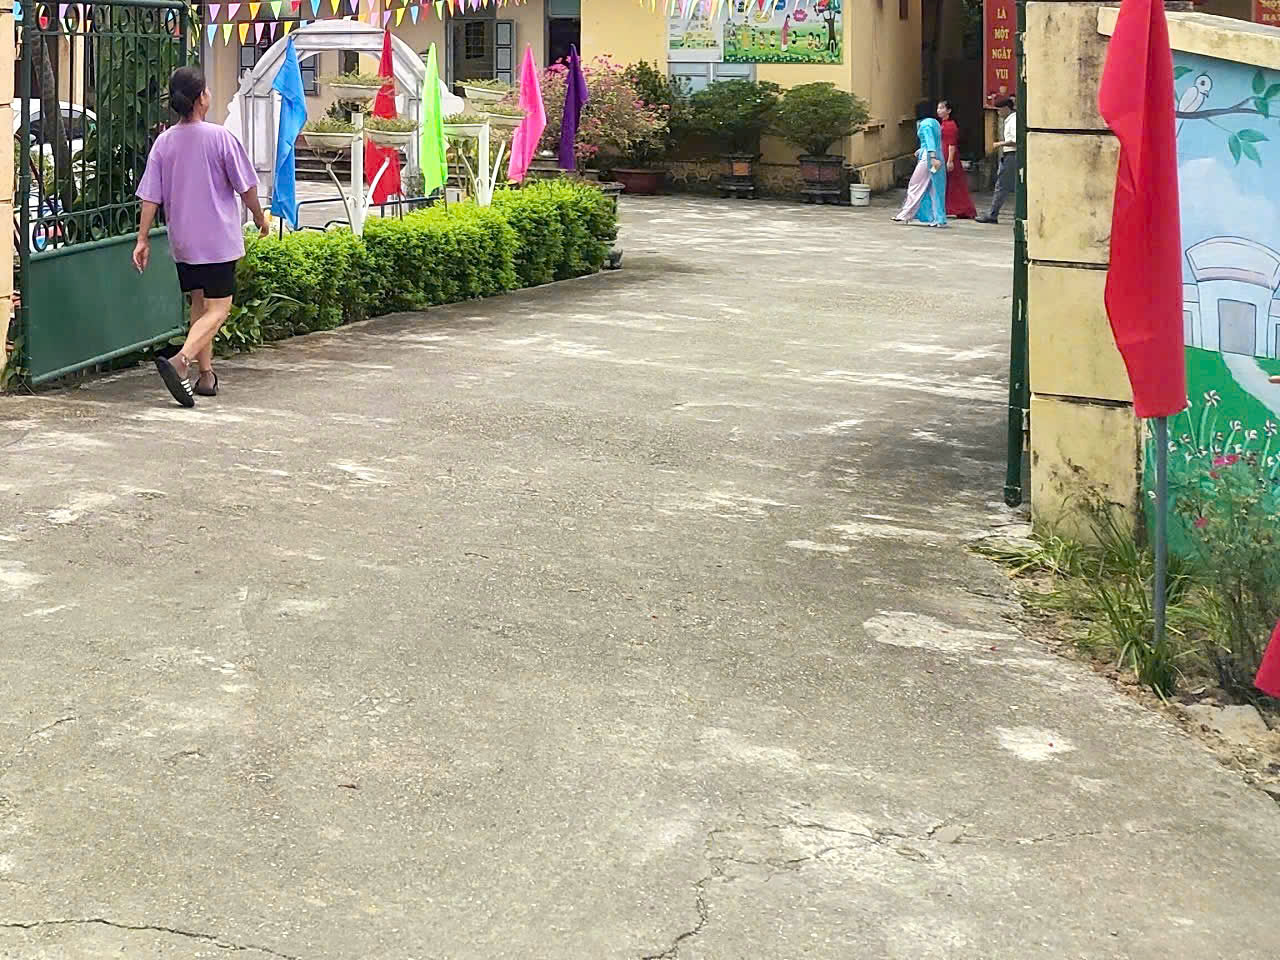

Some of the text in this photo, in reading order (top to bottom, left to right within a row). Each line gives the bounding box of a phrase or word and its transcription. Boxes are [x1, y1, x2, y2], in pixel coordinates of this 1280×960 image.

[996, 5, 1007, 19] LÀ
[994, 25, 1009, 42] MỘT
[991, 46, 1012, 60] NGÀY
[995, 68, 1009, 80] VUI
